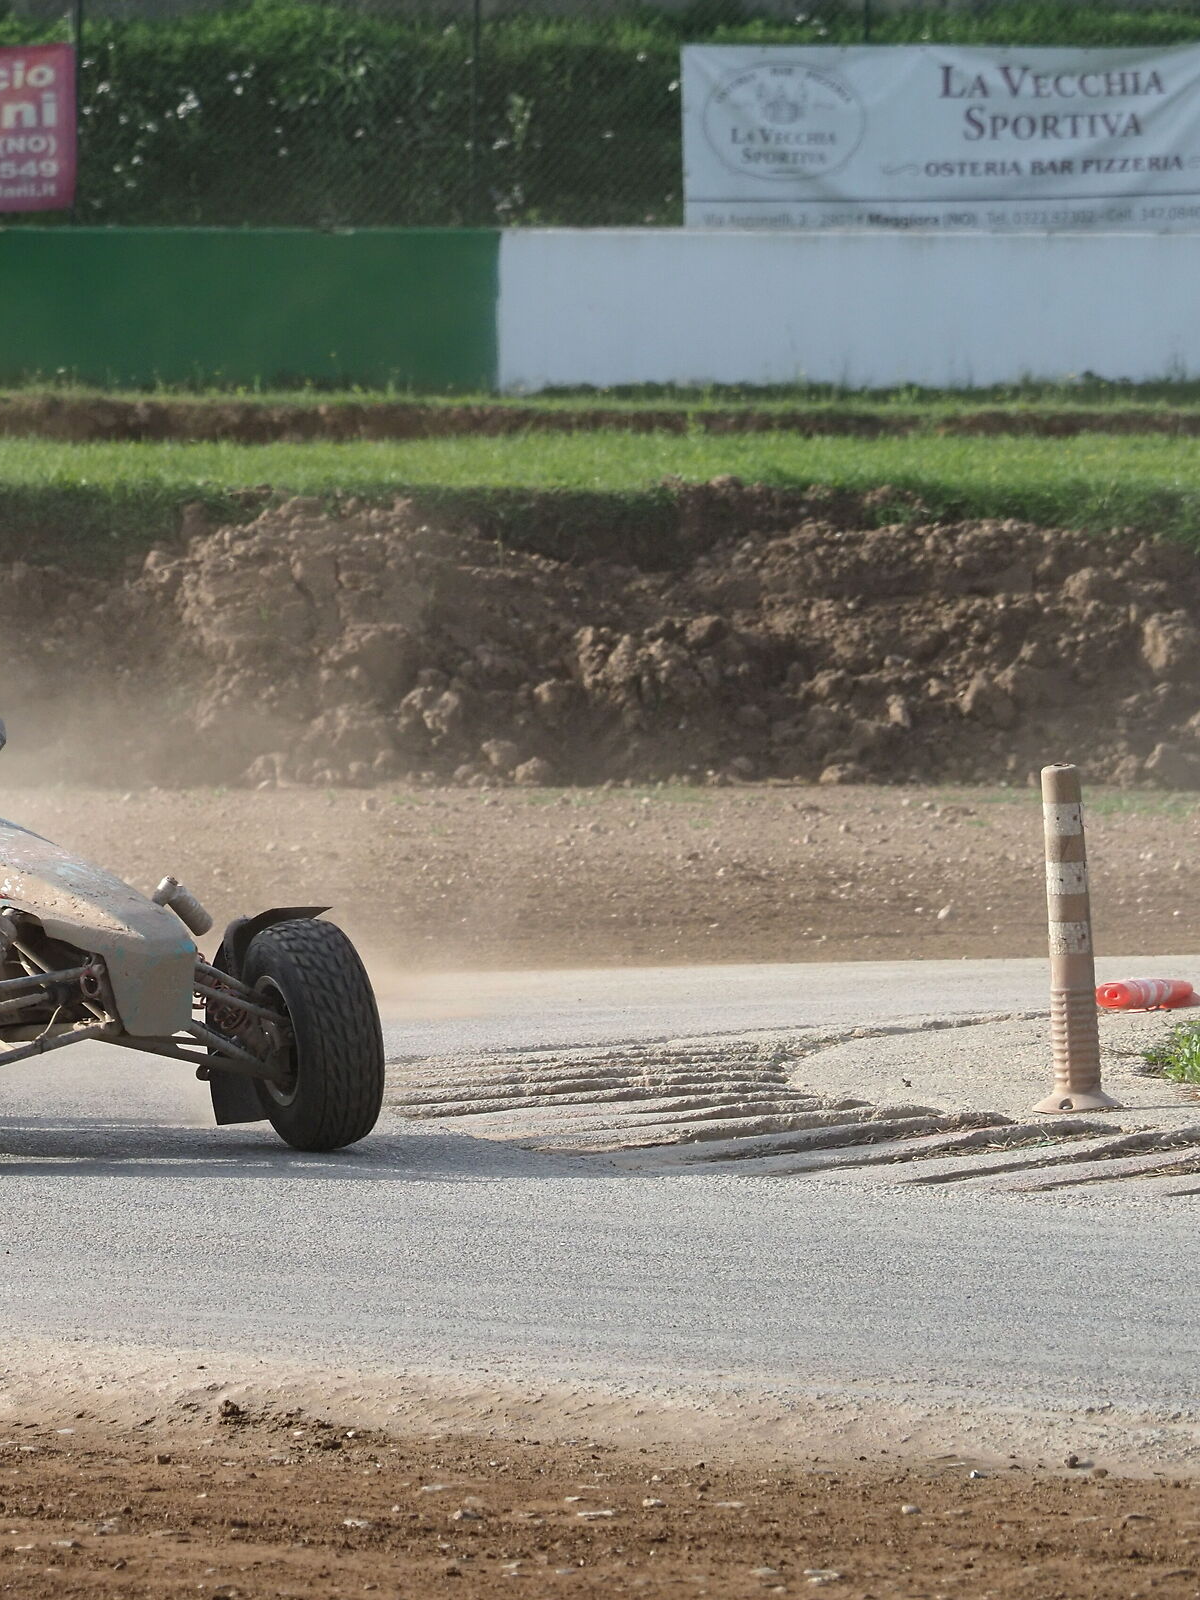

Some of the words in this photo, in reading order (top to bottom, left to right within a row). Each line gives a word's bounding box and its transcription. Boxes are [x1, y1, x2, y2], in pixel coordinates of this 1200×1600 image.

[939, 65, 990, 99] LA
[999, 65, 1166, 98] VECCHIA
[962, 104, 1142, 141] SPORTIVA
[924, 159, 1021, 178] OSTERIA
[1031, 158, 1074, 176] BAR
[1081, 154, 1184, 175] PIZZERIA
